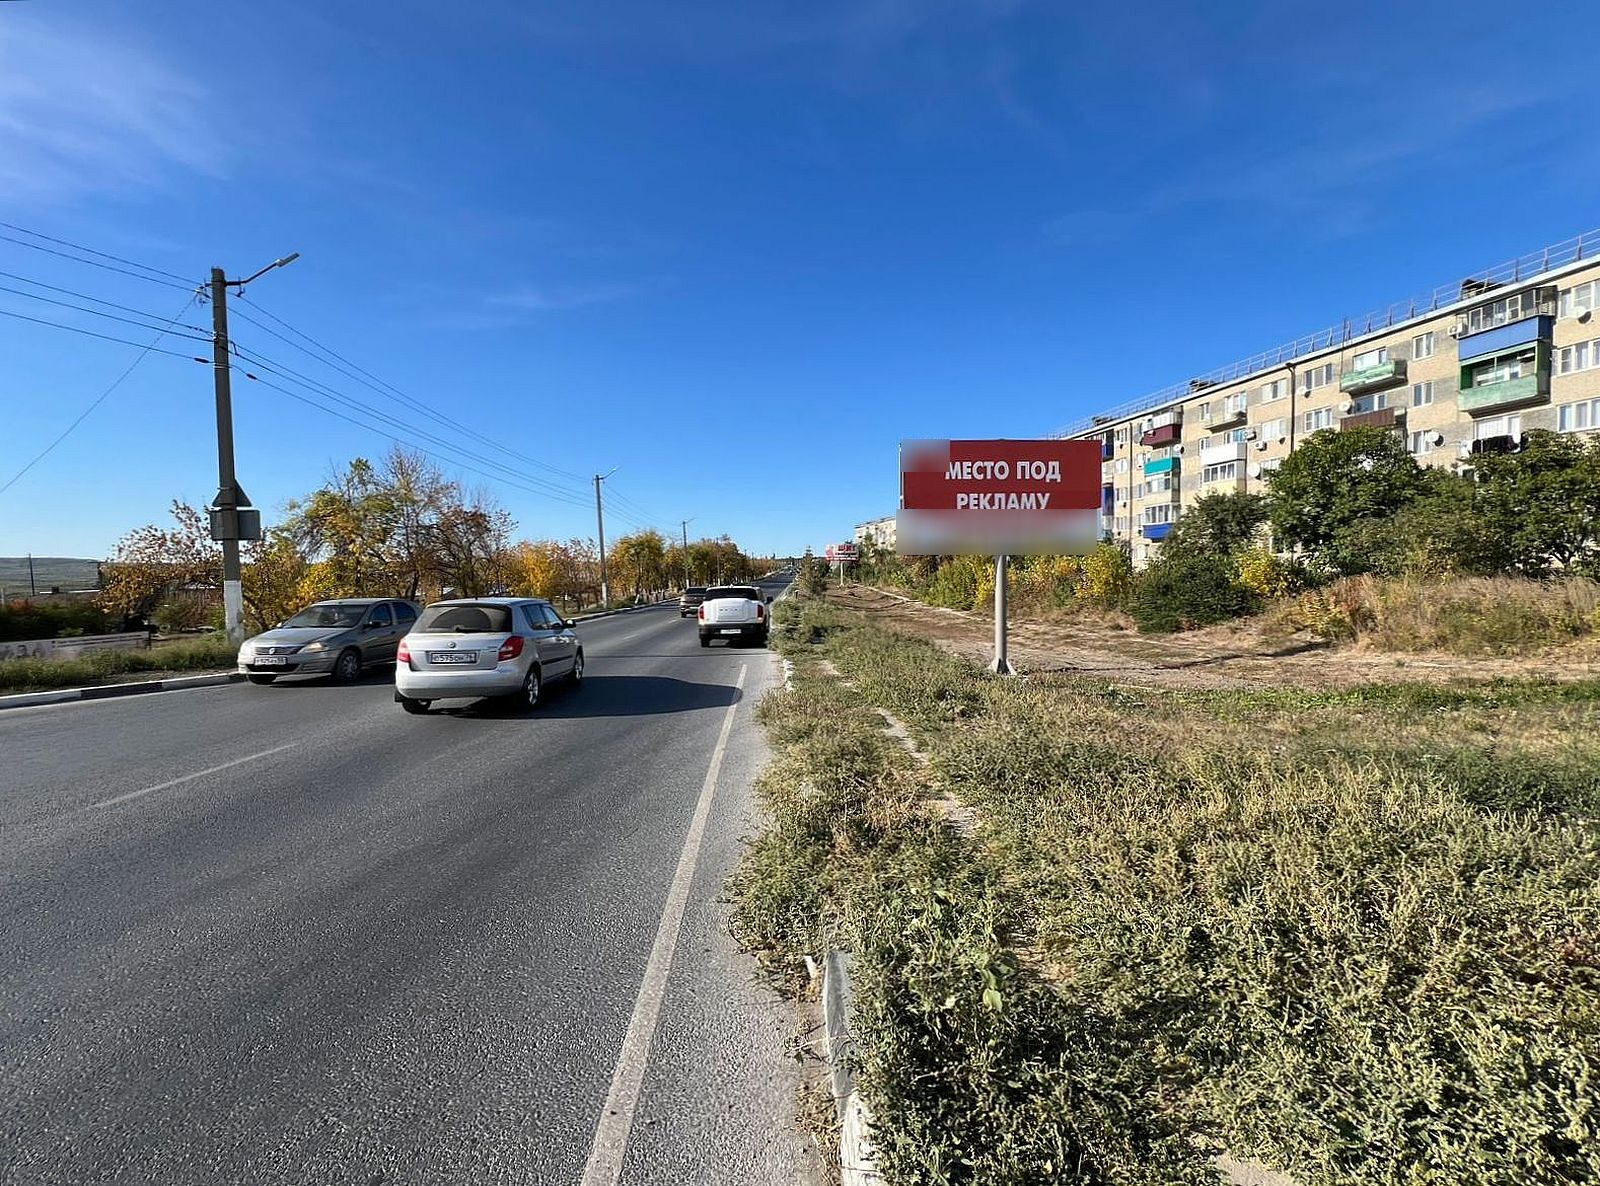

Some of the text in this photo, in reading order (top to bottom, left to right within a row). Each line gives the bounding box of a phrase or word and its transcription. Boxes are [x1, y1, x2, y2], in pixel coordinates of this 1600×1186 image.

[945, 460, 1061, 482] МЕСТО ПОД
[956, 493, 1050, 509] РЕКЛАМУ
